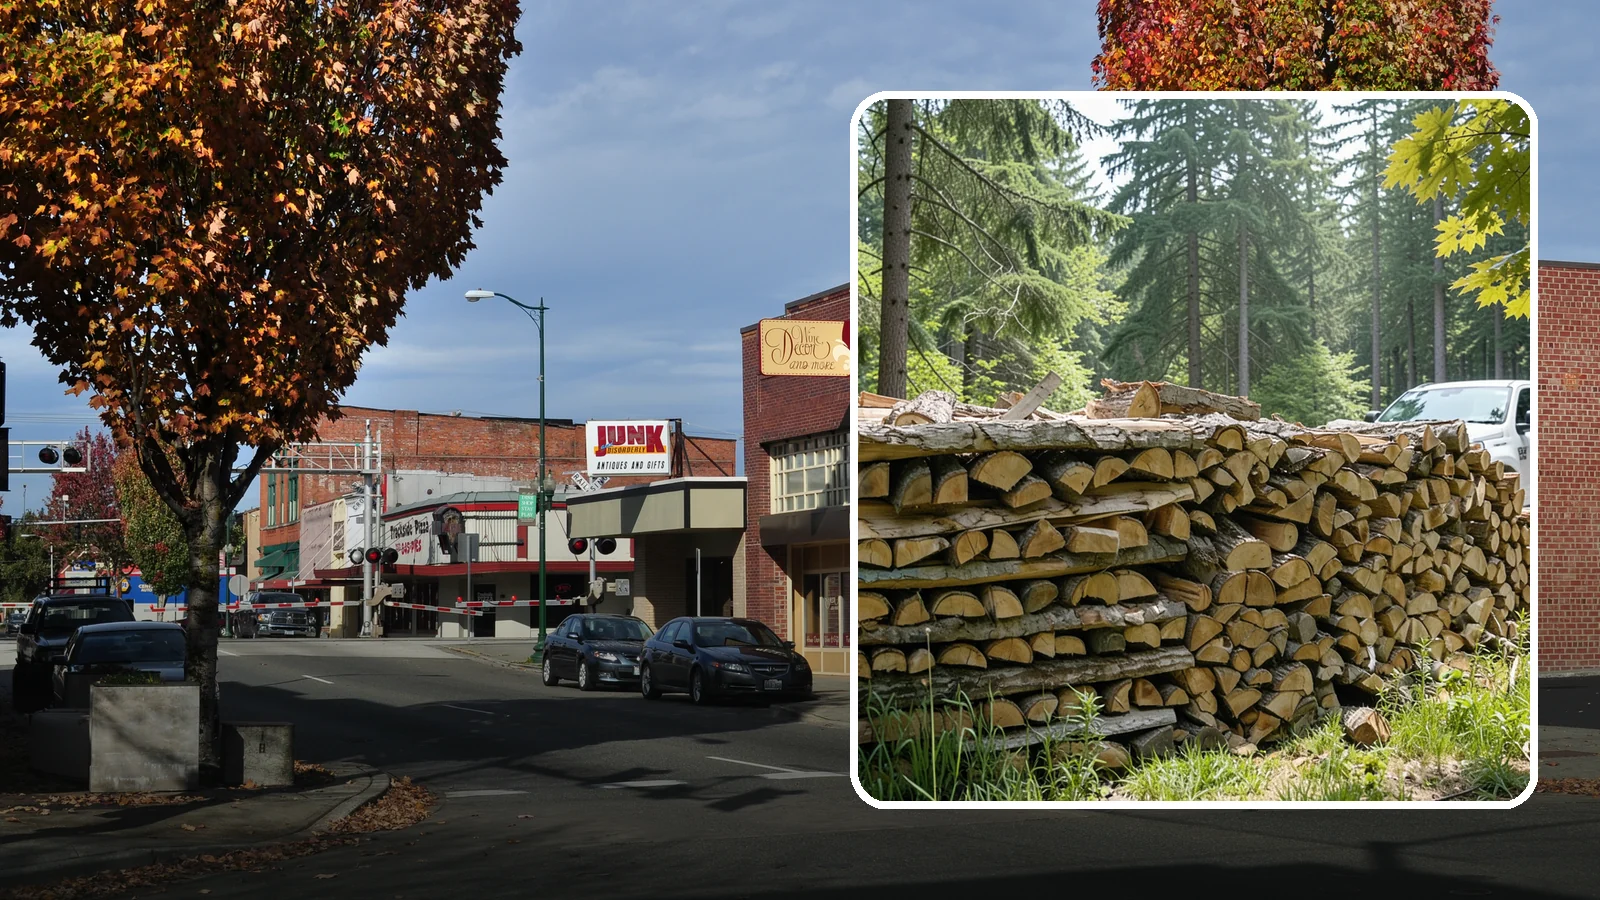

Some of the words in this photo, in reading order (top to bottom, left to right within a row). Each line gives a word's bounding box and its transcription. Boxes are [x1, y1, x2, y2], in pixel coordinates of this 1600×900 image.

[595, 425, 665, 457] JUNK
[597, 461, 628, 470] ANTIQUES
[631, 461, 643, 470] AND
[647, 460, 665, 469] GIFTS
[352, 498, 365, 511] CRO
[414, 520, 429, 534] Pizza
